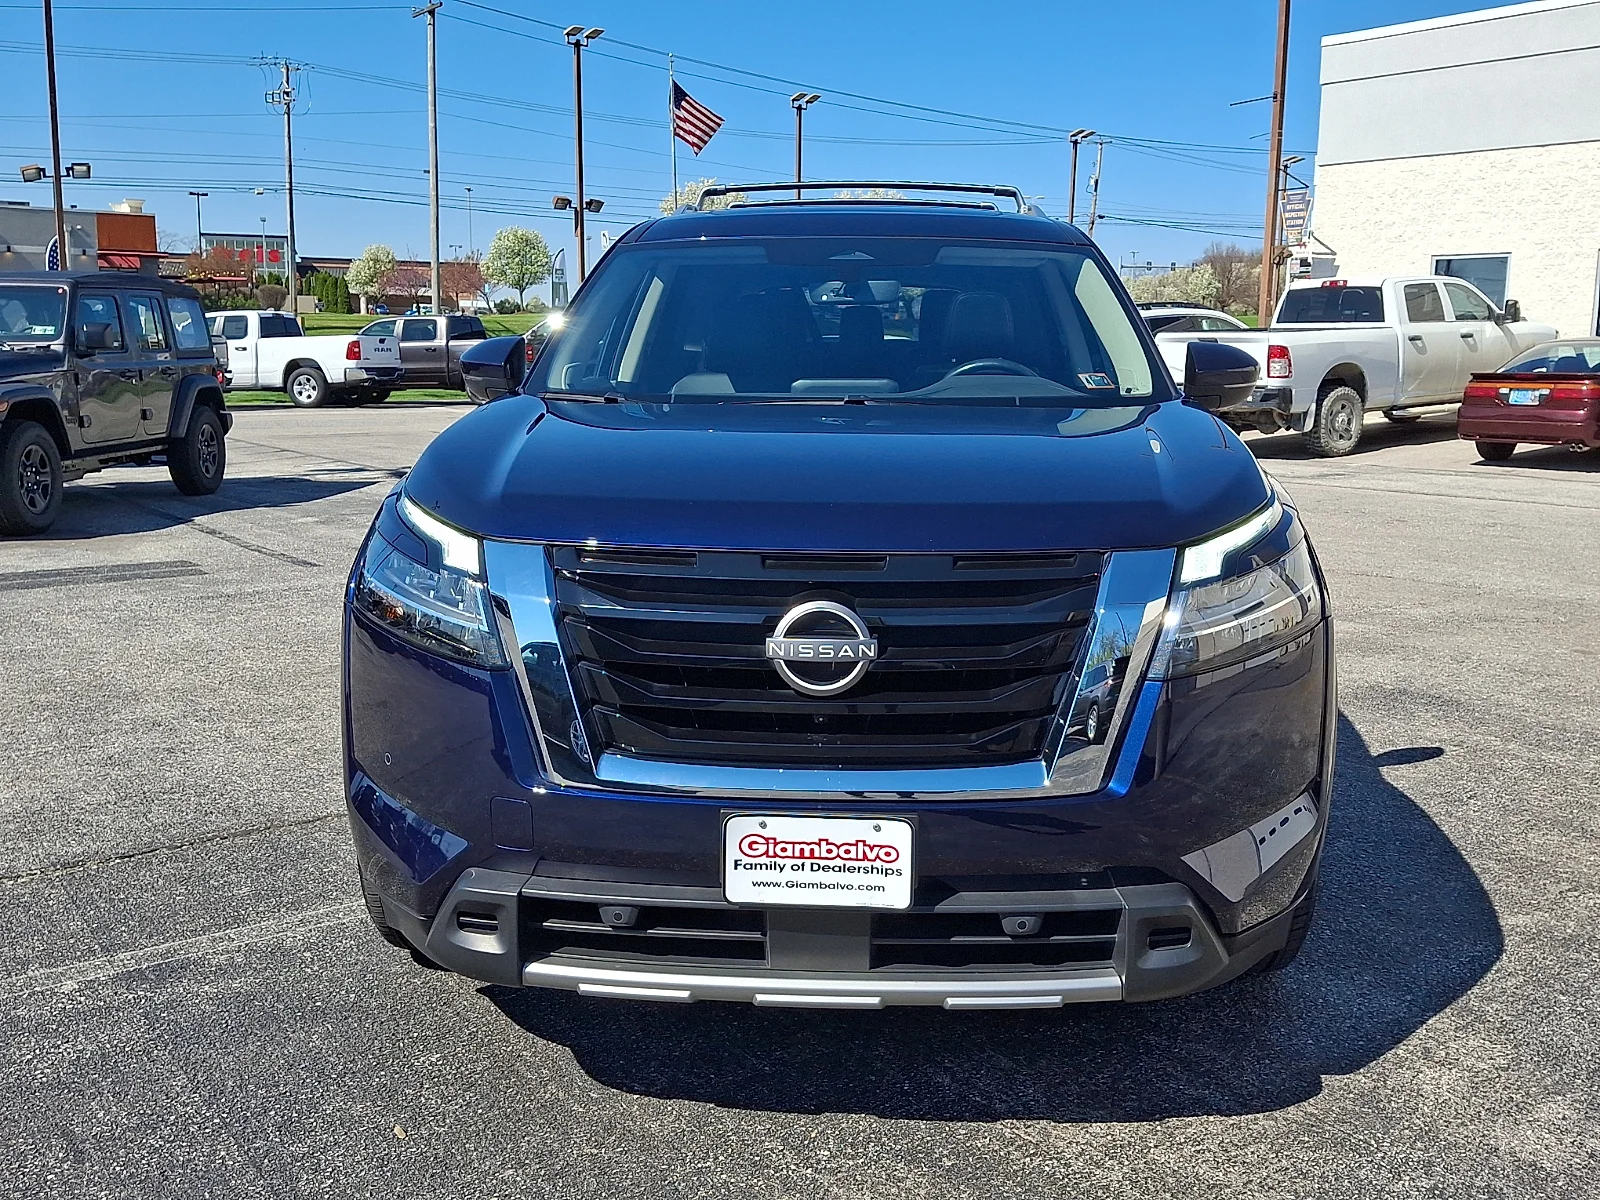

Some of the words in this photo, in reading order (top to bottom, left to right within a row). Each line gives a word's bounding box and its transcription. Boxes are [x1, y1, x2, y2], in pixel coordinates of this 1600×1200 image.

[768, 642, 875, 658] NISSAN
[739, 833, 899, 863] Giambalvo
[733, 859, 786, 873] Family
[790, 861, 805, 872] of
[810, 862, 903, 878] Dealerships
[751, 880, 885, 893] www.Giambalvo.com
